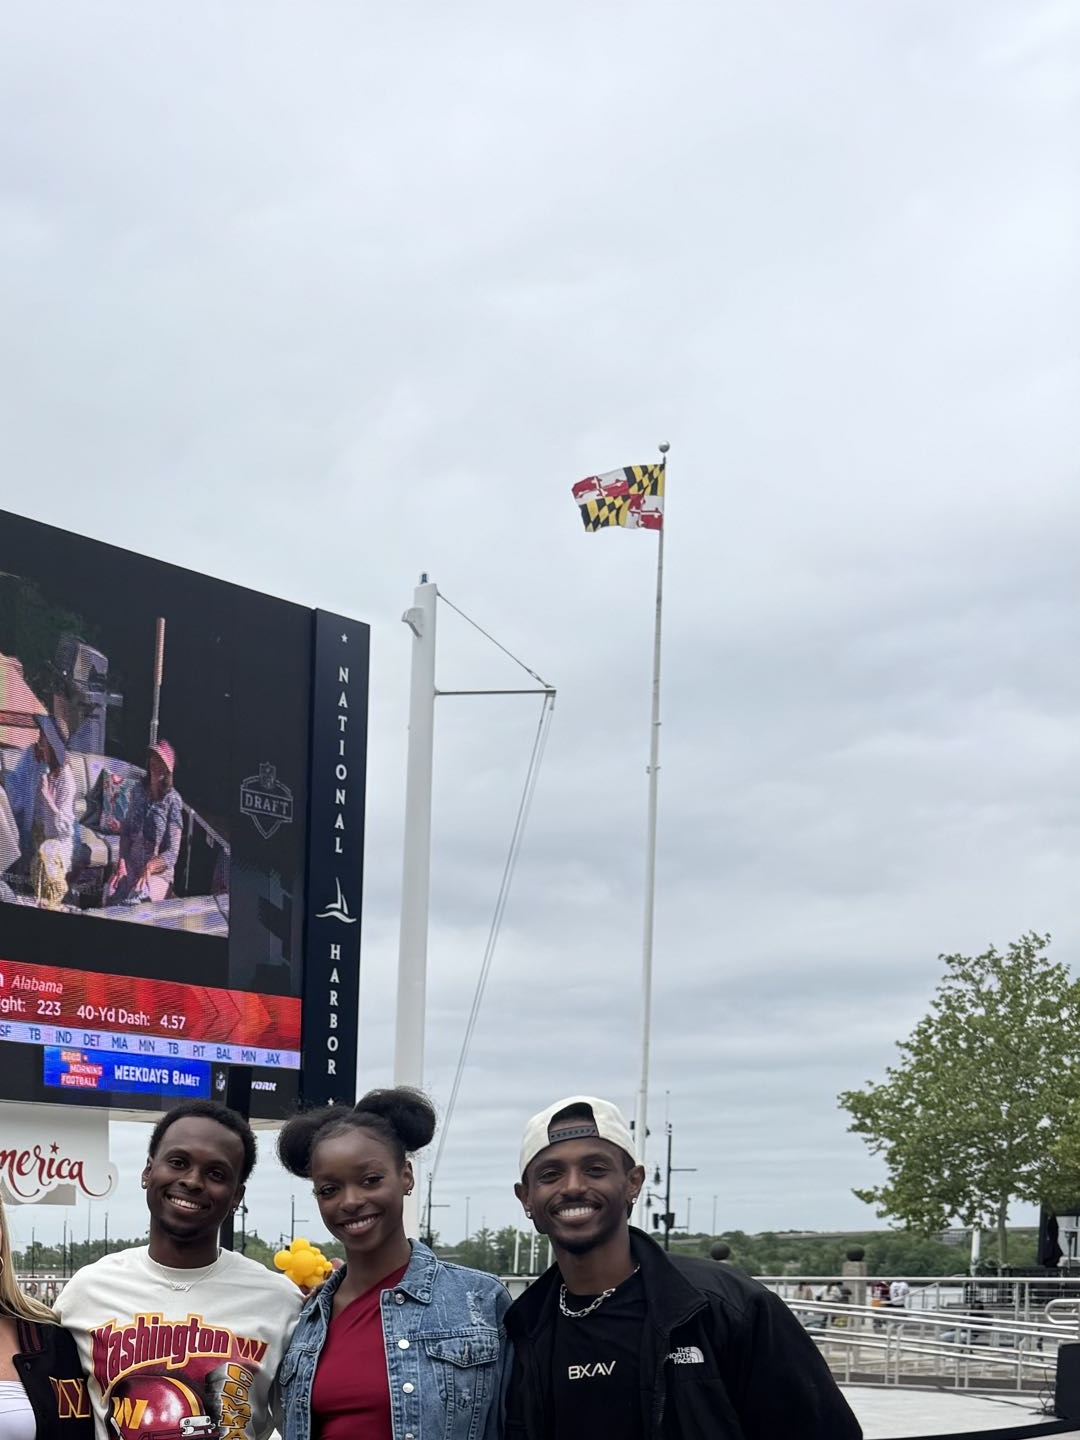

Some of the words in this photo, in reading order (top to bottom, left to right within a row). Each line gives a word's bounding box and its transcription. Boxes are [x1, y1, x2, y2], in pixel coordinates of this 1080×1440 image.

[334, 666, 350, 854] NATIONAL
[245, 793, 289, 815] DRAFT
[11, 974, 63, 994] Alabama
[37, 1000, 61, 1016] 223
[77, 1005, 115, 1023] 40-Yd
[118, 1008, 150, 1027] Dash:
[160, 1015, 186, 1030] 4.57
[328, 944, 342, 1075] HARBOR
[0, 1024, 12, 1037] SF
[28, 1027, 41, 1040] TB
[55, 1031, 72, 1043] IND
[83, 1034, 100, 1046] DET
[112, 1037, 128, 1049] MIA
[139, 1040, 155, 1052] MIN
[167, 1043, 179, 1055] TB
[193, 1045, 206, 1057] PIT
[216, 1048, 232, 1060] BAL
[241, 1051, 256, 1062] MIN
[265, 1053, 280, 1065] JAX
[115, 1065, 168, 1084] WEEKDAYS
[91, 1316, 230, 1394] Washington
[664, 1352, 691, 1360] NORTH
